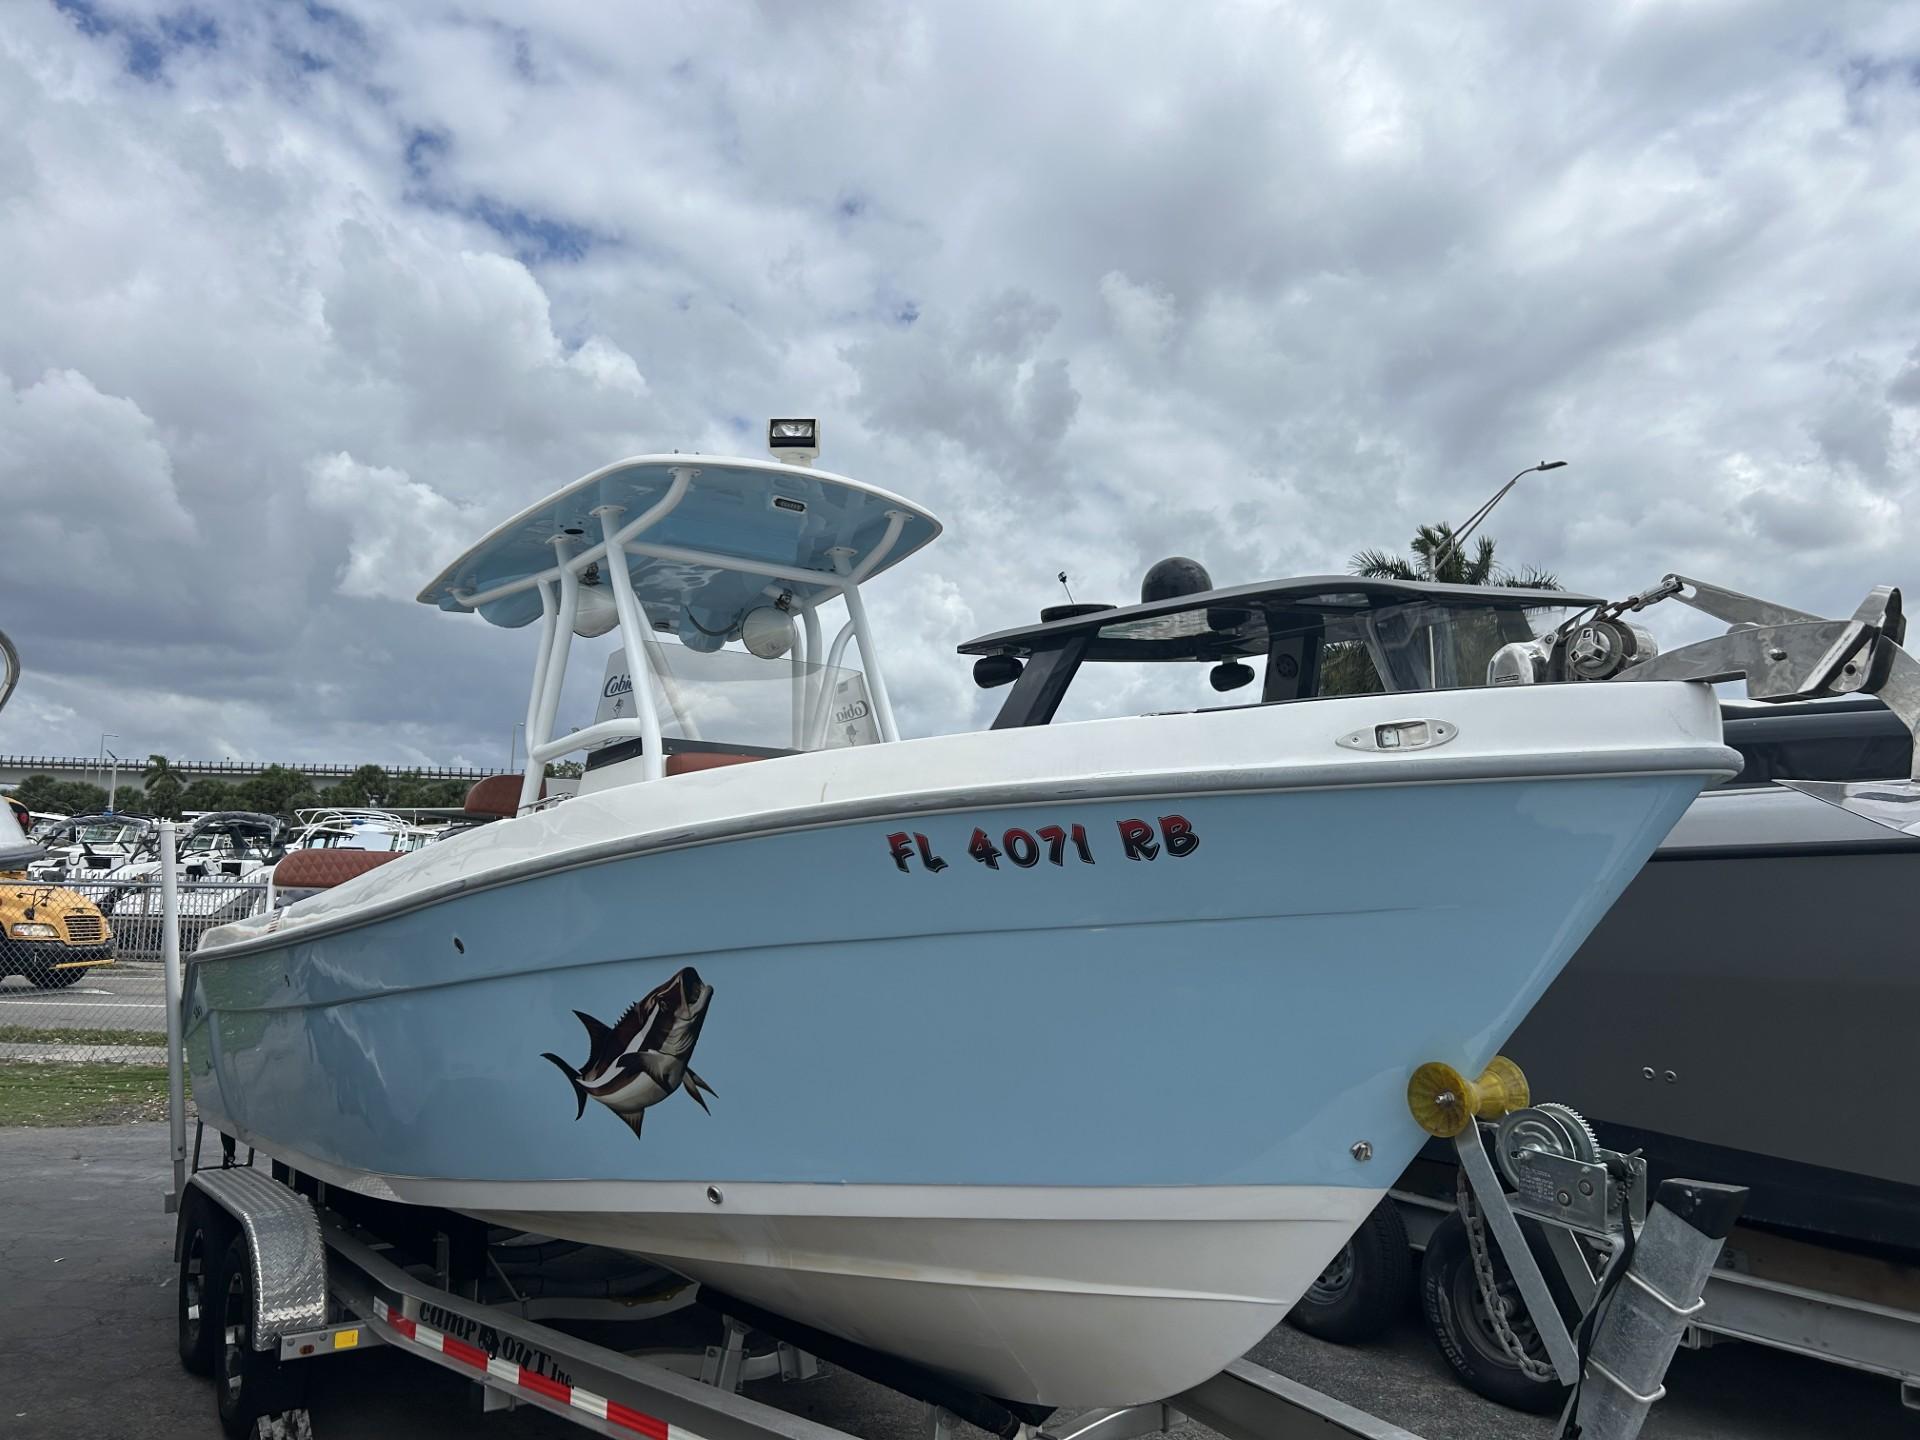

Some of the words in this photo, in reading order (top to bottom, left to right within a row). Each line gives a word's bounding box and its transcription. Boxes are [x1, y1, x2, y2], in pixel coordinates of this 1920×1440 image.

[886, 831, 948, 873] FL
[968, 824, 1095, 870] 4071
[1116, 814, 1199, 861] RB
